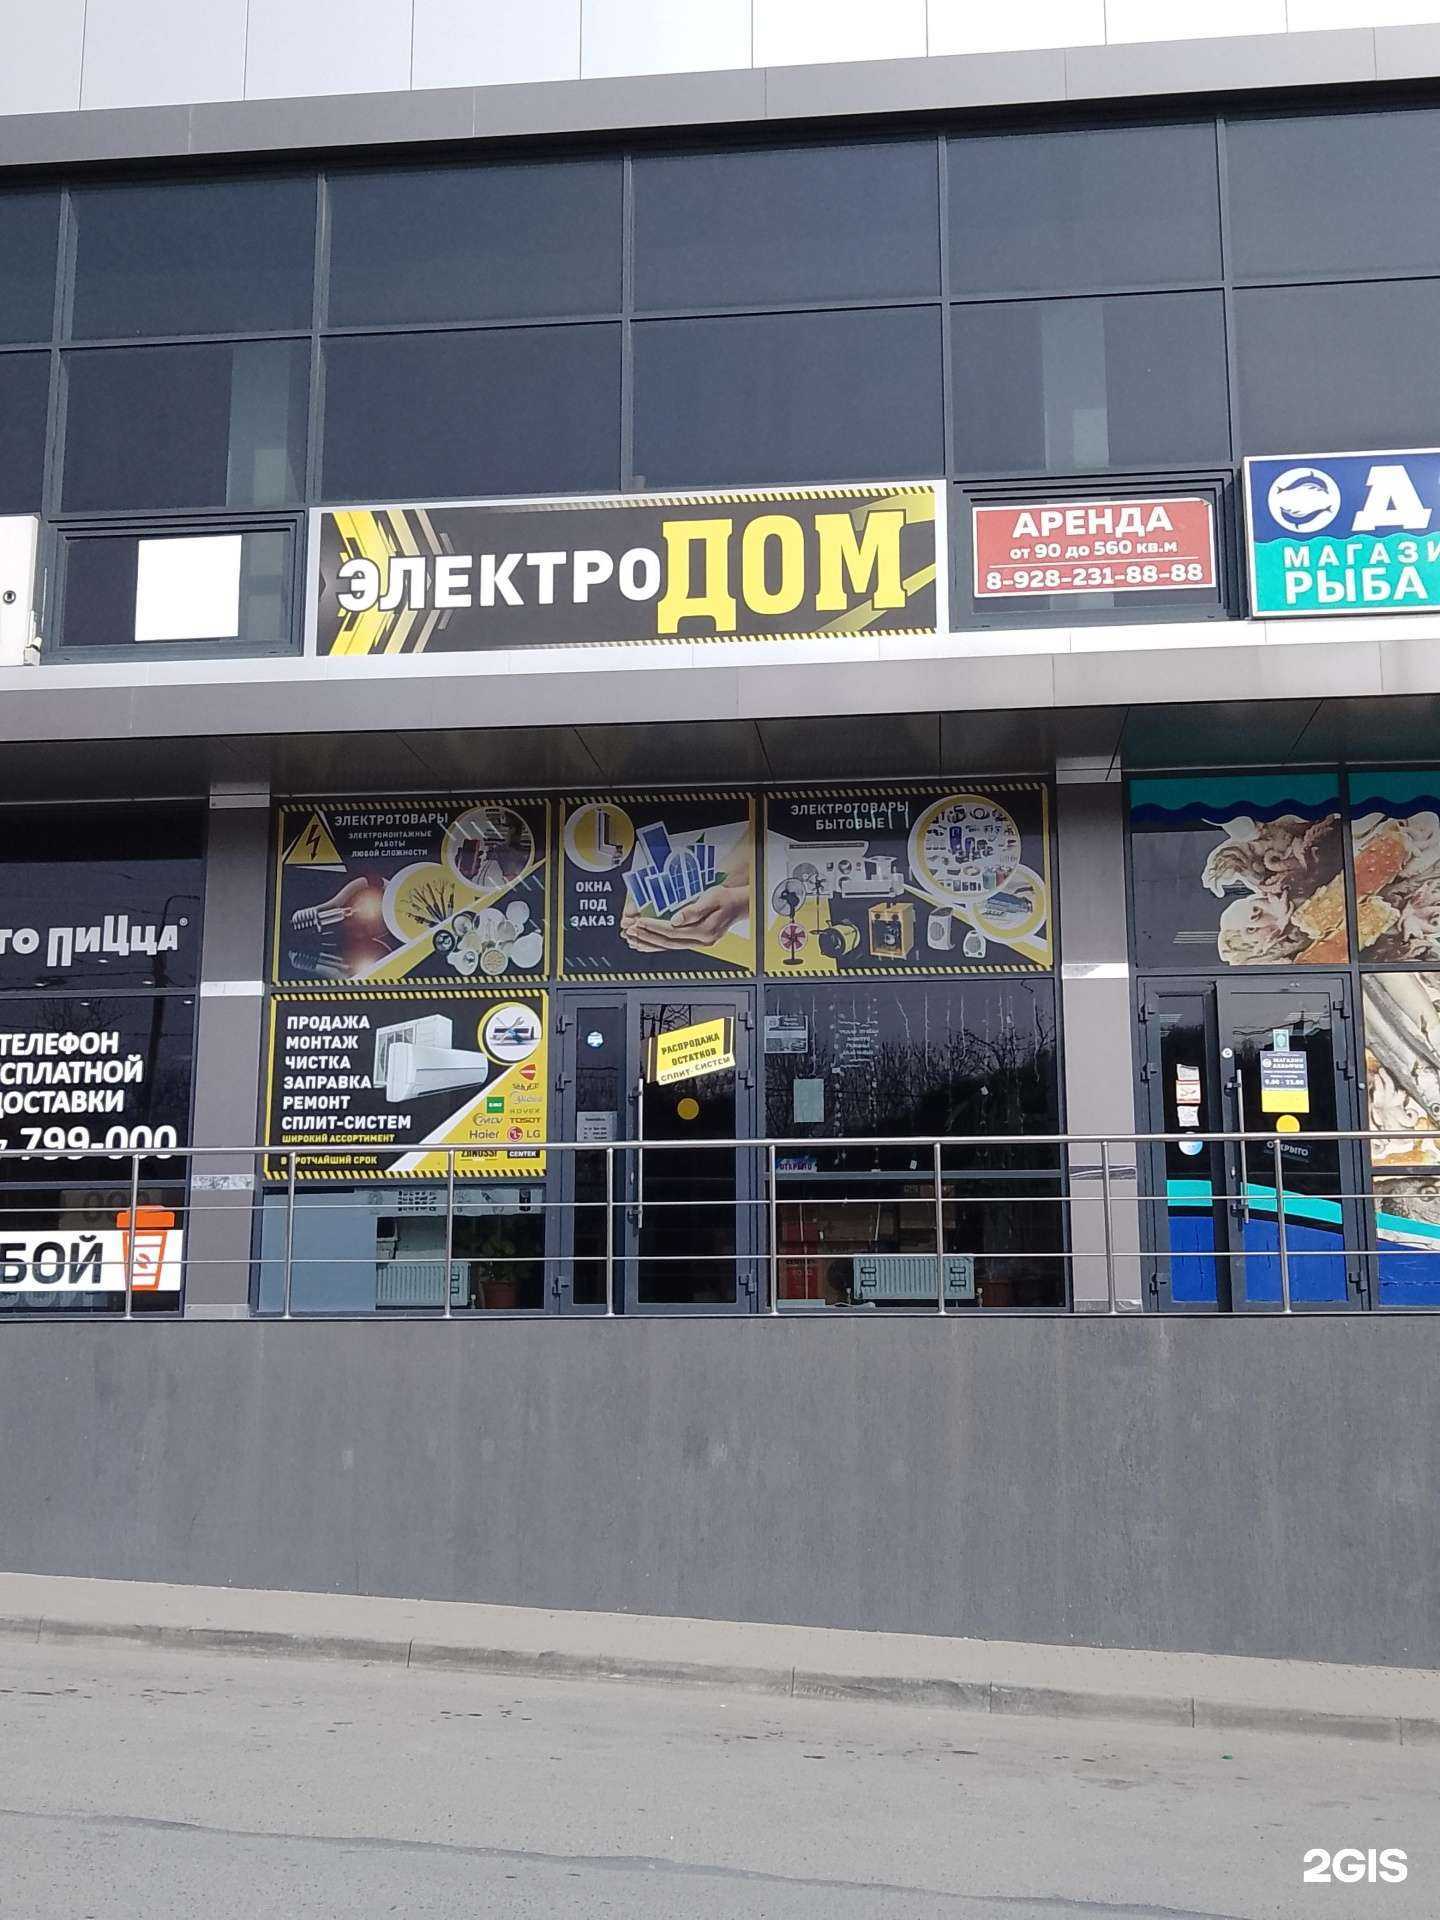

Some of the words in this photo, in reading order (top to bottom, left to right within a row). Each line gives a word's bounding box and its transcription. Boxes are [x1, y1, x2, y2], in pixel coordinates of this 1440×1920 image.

[1351, 464, 1440, 531] Д
[1012, 506, 1173, 538] АРЕНДА
[1010, 548, 1030, 559] от
[1034, 543, 1060, 559] 90
[1065, 546, 1090, 559] до
[1094, 540, 1132, 555] 560
[1136, 541, 1177, 553] кв.м
[336, 510, 906, 634] ЭЛЕКТРОДОМ
[986, 563, 1203, 590] 8-928-231-88-88
[1284, 565, 1428, 605] РЫБА
[790, 801, 909, 815] ЭЛЕКТРОТОВАРЫ
[334, 812, 448, 826] ЭЛЕКТРОТОВАРЫ
[816, 817, 886, 830] БЫТОВЫЕ
[348, 830, 432, 840] ЭЛЕКТРОМОНТАЖНЫЕ
[374, 840, 406, 848] РАБОТЫ
[351, 849, 380, 858] ЛЮБОЙ
[381, 848, 428, 857] СЛОЖНОСТИ
[575, 881, 612, 893] ОКНА
[579, 898, 608, 912] ПОД
[570, 915, 615, 927] ЗАКАЗ
[286, 1015, 370, 1031] ПРОДАЖА
[285, 1035, 359, 1050] МОНТАЖ
[661, 1032, 720, 1055] РАСПРОДАЖА
[284, 1055, 351, 1069] ЧИСТКА
[671, 1047, 717, 1066] ОСТАТКОВ
[283, 1075, 372, 1089] ЗАПРАВКА
[0, 1089, 124, 1118] ОСТАВКИ
[282, 1096, 351, 1110] РЕМОНТ
[281, 1115, 412, 1130] СПЛИТ-СИСТЕМ
[282, 1133, 328, 1143] ШИРОКИЙ
[329, 1134, 395, 1143] АССОРТИМЕНТ
[469, 1129, 500, 1139] Haier
[20, 1125, 178, 1160] 799-000
[294, 1155, 352, 1165] РОТЧАЙШИЙ
[354, 1156, 378, 1165] СРОК
